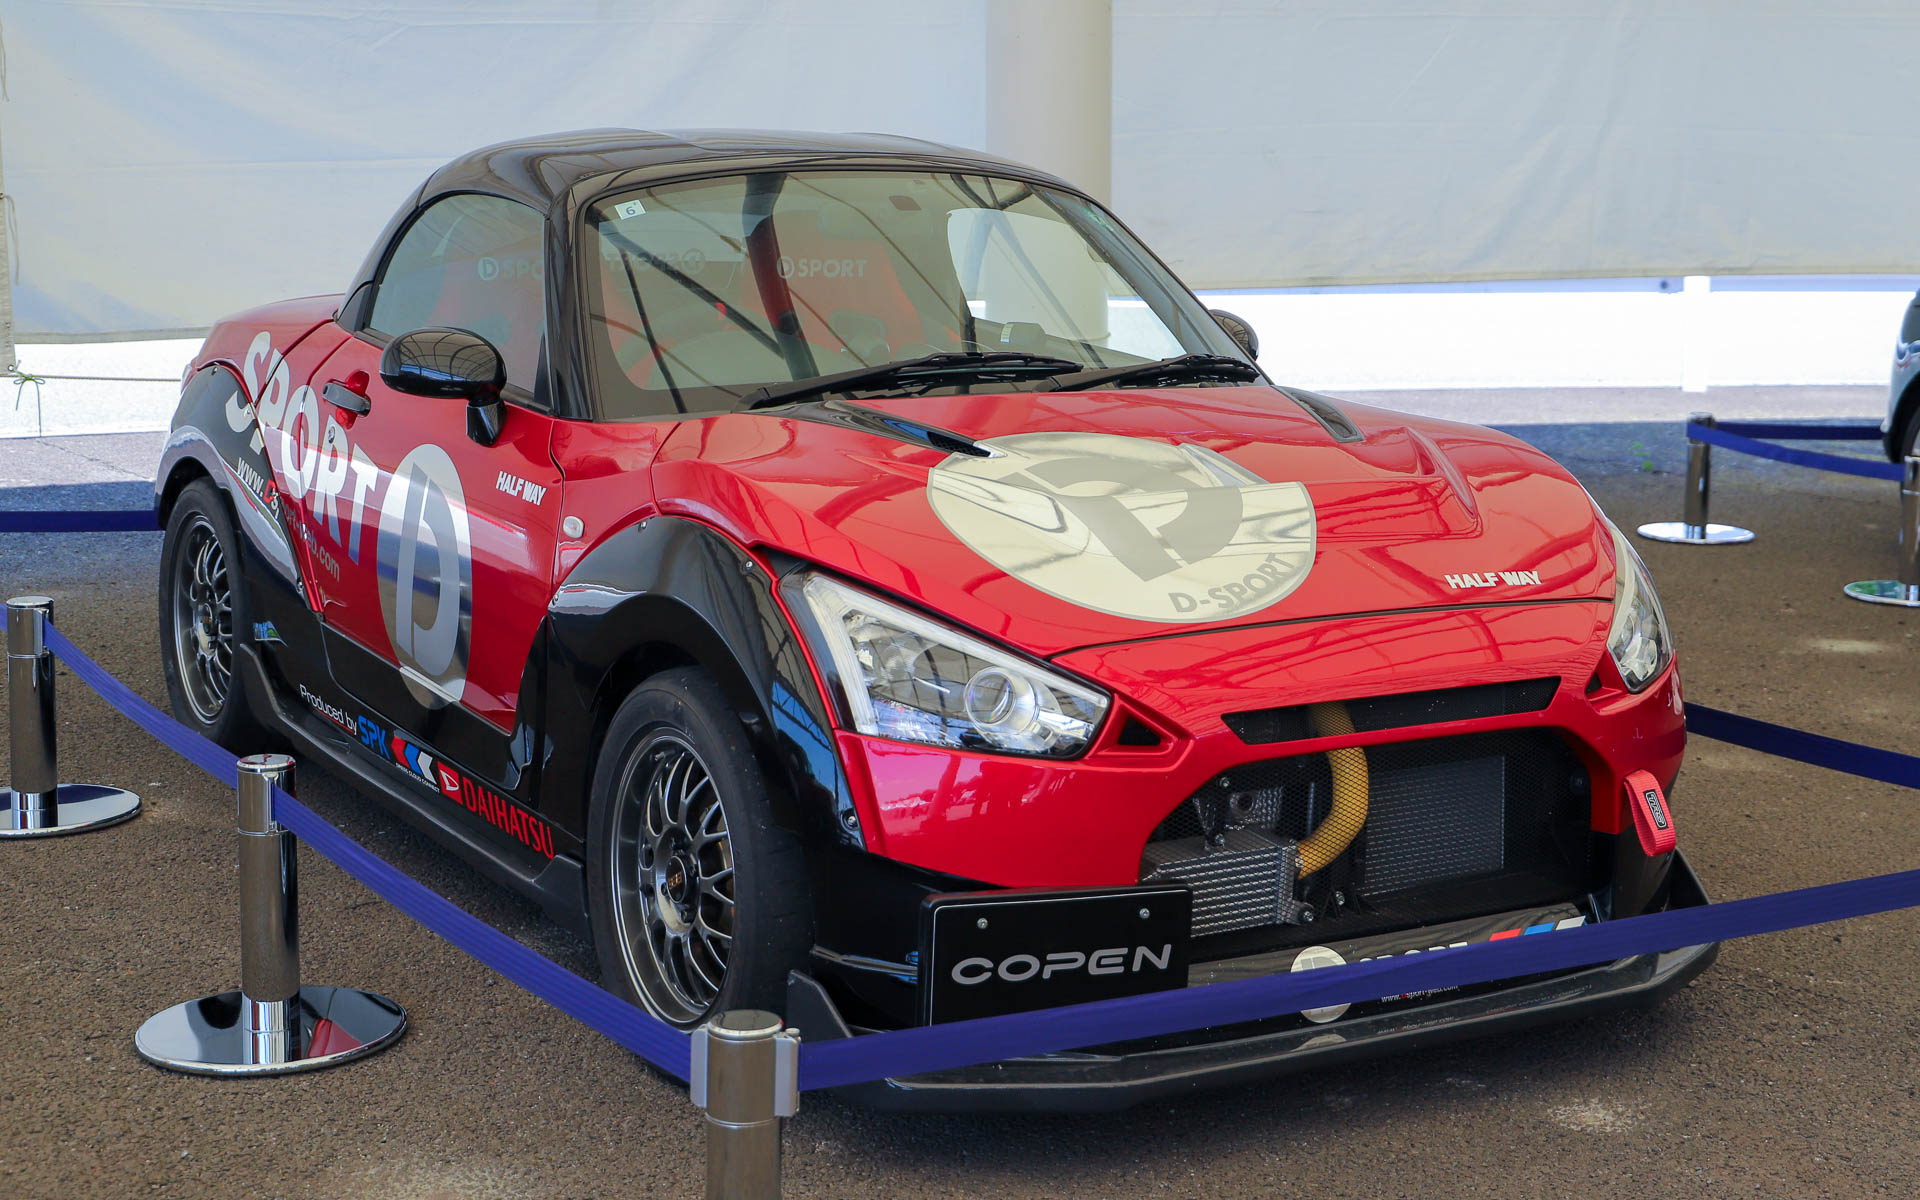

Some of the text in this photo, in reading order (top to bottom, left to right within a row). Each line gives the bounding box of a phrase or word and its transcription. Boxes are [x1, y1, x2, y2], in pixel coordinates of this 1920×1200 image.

[798, 257, 868, 279] SPORT
[226, 331, 378, 565] SPORT
[496, 470, 547, 506] HALF WAY
[1167, 551, 1299, 614] D-SPORT
[1443, 570, 1543, 589] HALF WAY
[299, 683, 391, 761] Produced by SPK
[462, 777, 555, 860] DAIHATSU
[951, 943, 1172, 985] COPEN
